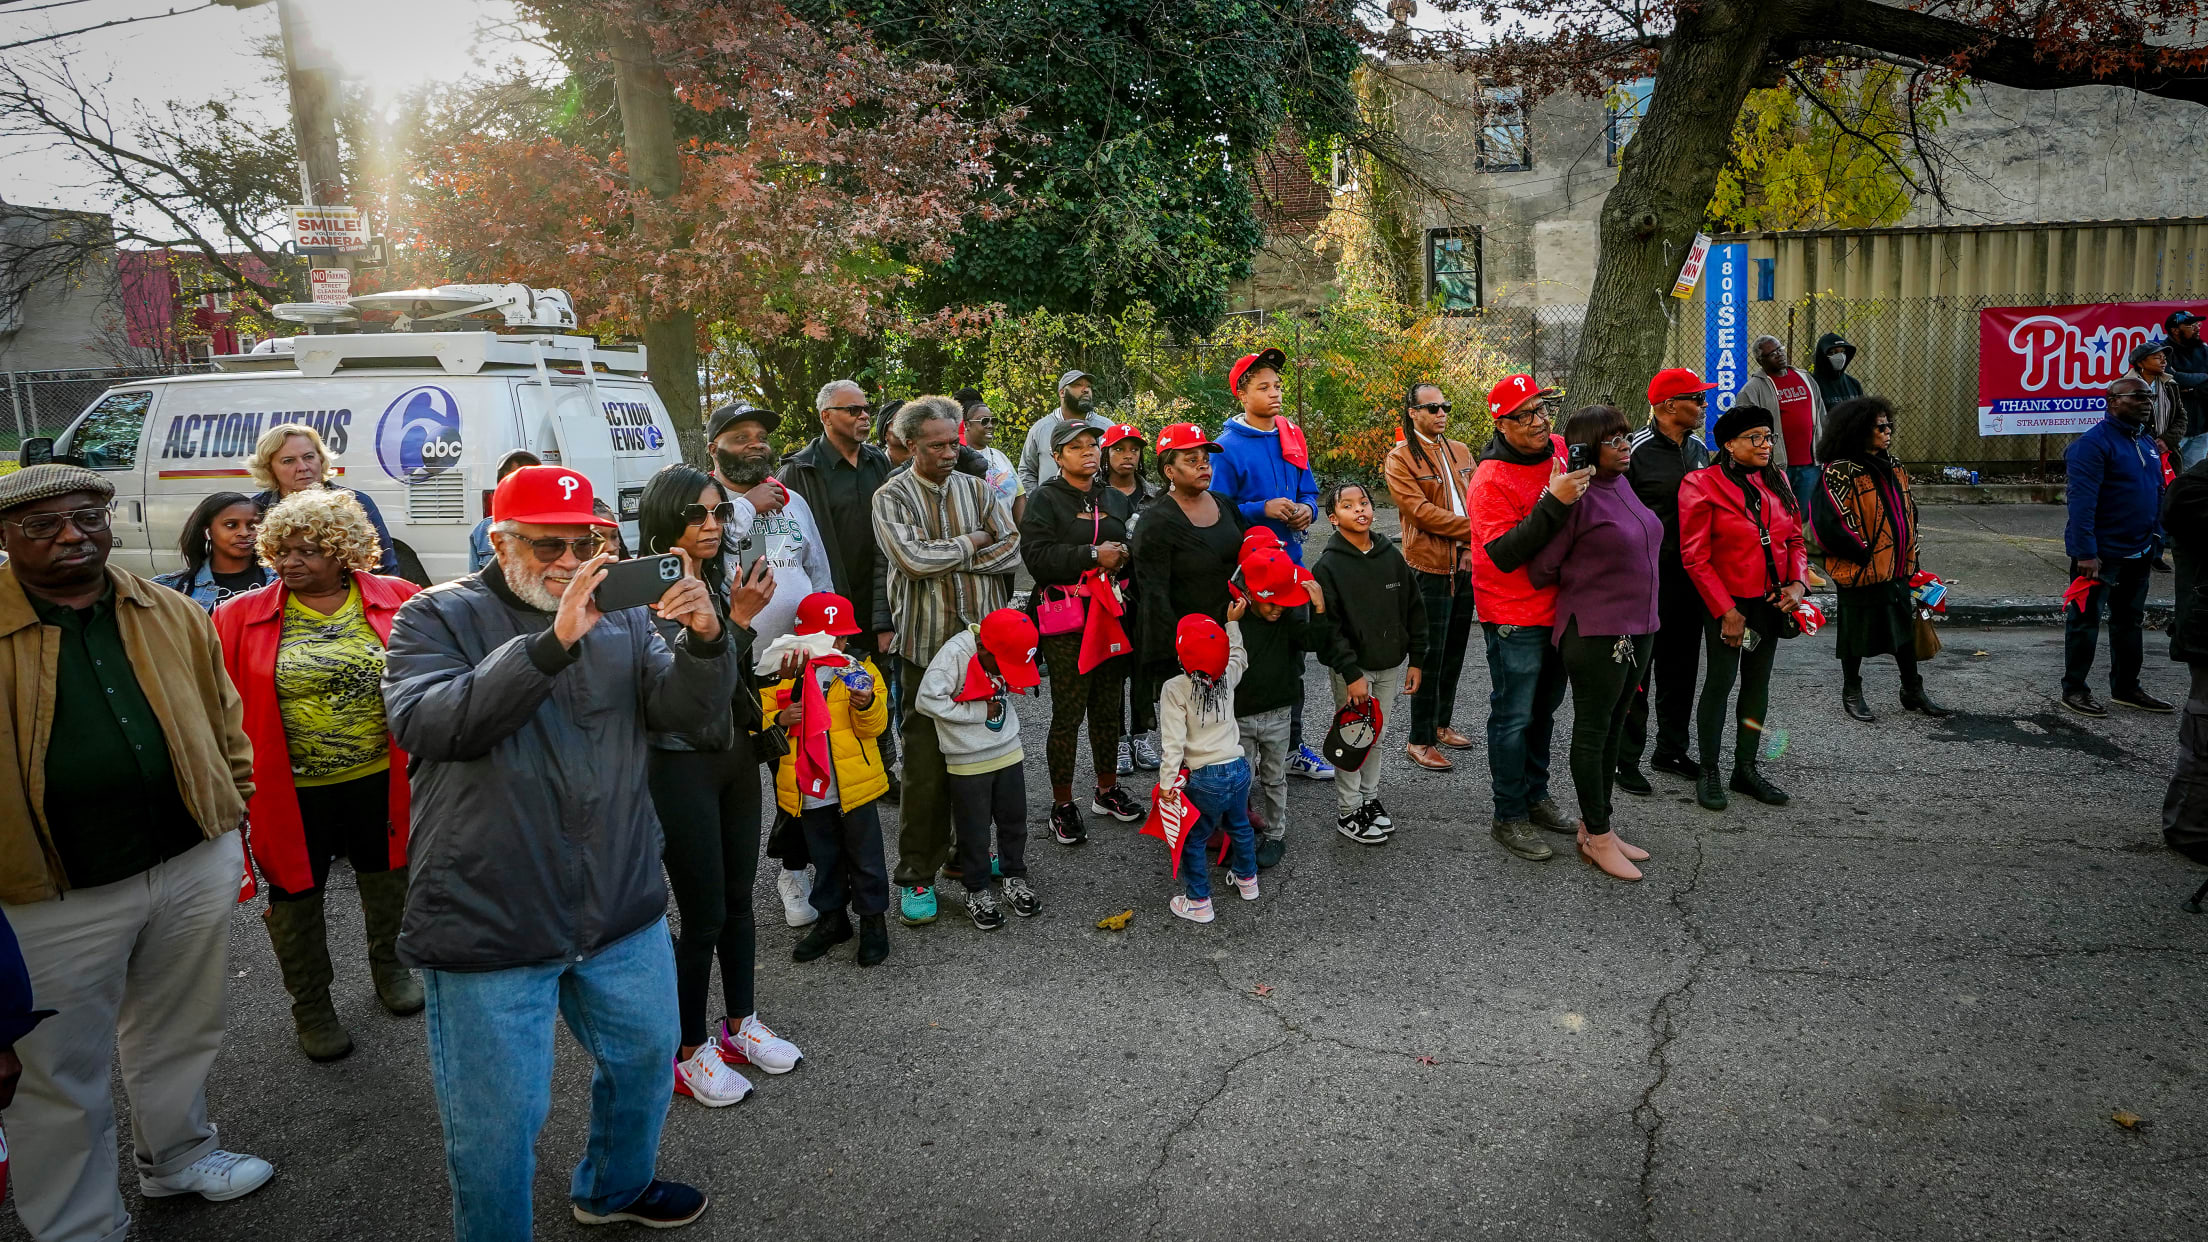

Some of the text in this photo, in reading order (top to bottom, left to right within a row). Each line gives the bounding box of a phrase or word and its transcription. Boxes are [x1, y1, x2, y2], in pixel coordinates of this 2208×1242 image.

[297, 219, 362, 231] SMILE!
[299, 236, 363, 247] CAMERA
[313, 271, 347, 281] NO PARKING
[1513, 377, 1526, 392] P
[1777, 385, 1808, 400] POLO
[1999, 397, 2108, 412] THANK YOU FO
[2016, 417, 2076, 427] STRAWBERRY
[162, 411, 264, 459] ACTION
[1121, 425, 1132, 436] P
[1190, 425, 1200, 439] P
[421, 435, 462, 458] abc
[558, 476, 579, 501] P
[824, 605, 839, 625] P
